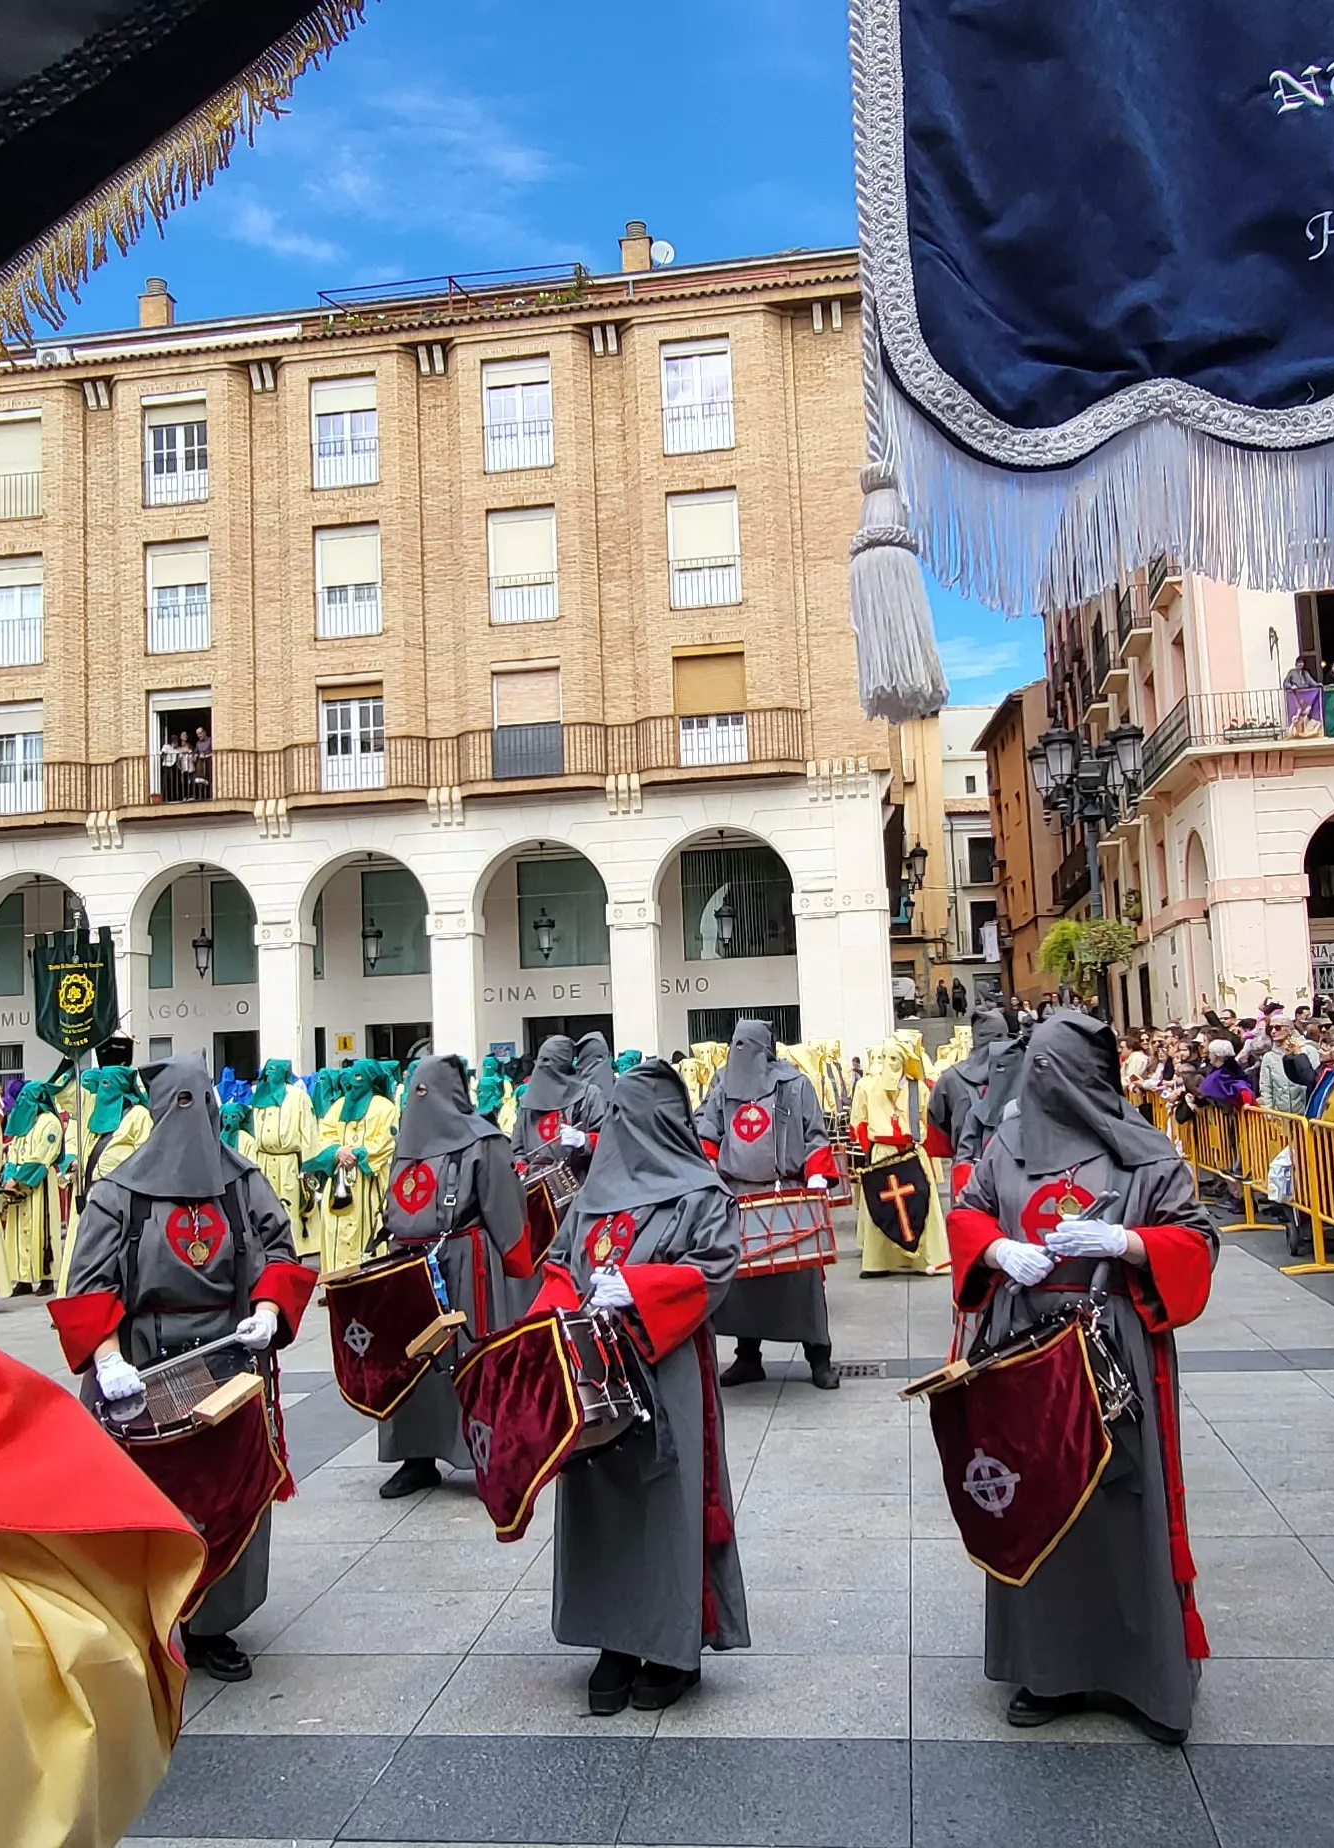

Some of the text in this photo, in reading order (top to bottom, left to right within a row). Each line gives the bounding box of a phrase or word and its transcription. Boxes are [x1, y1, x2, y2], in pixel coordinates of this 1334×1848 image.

[1310, 945, 1329, 958] RIA
[483, 986, 537, 1003] CINA
[553, 984, 582, 1000] DE
[1, 1011, 30, 1028] MU
